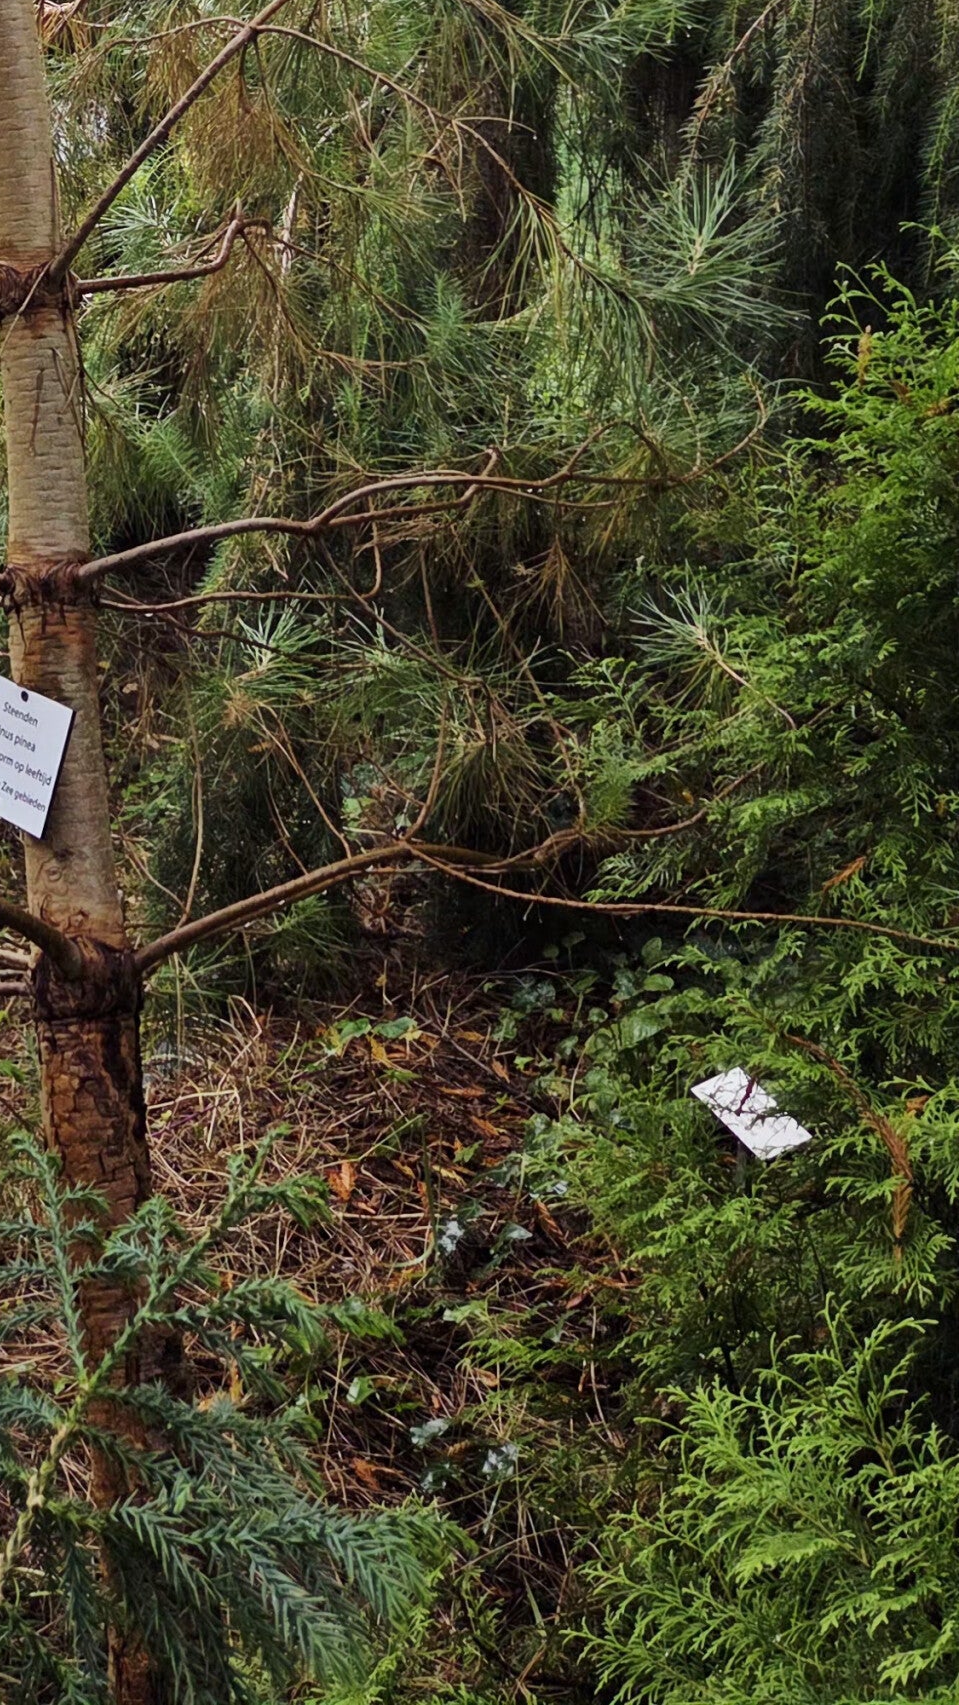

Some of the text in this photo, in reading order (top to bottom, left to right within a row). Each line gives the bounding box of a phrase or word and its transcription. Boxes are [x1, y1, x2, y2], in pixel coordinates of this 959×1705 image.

[2, 701, 39, 727] Steenden
[14, 734, 36, 752] pinea
[14, 761, 25, 774] op
[25, 763, 53, 787] leeftijd
[1, 781, 15, 796] Zee
[14, 790, 46, 812] gebieden
